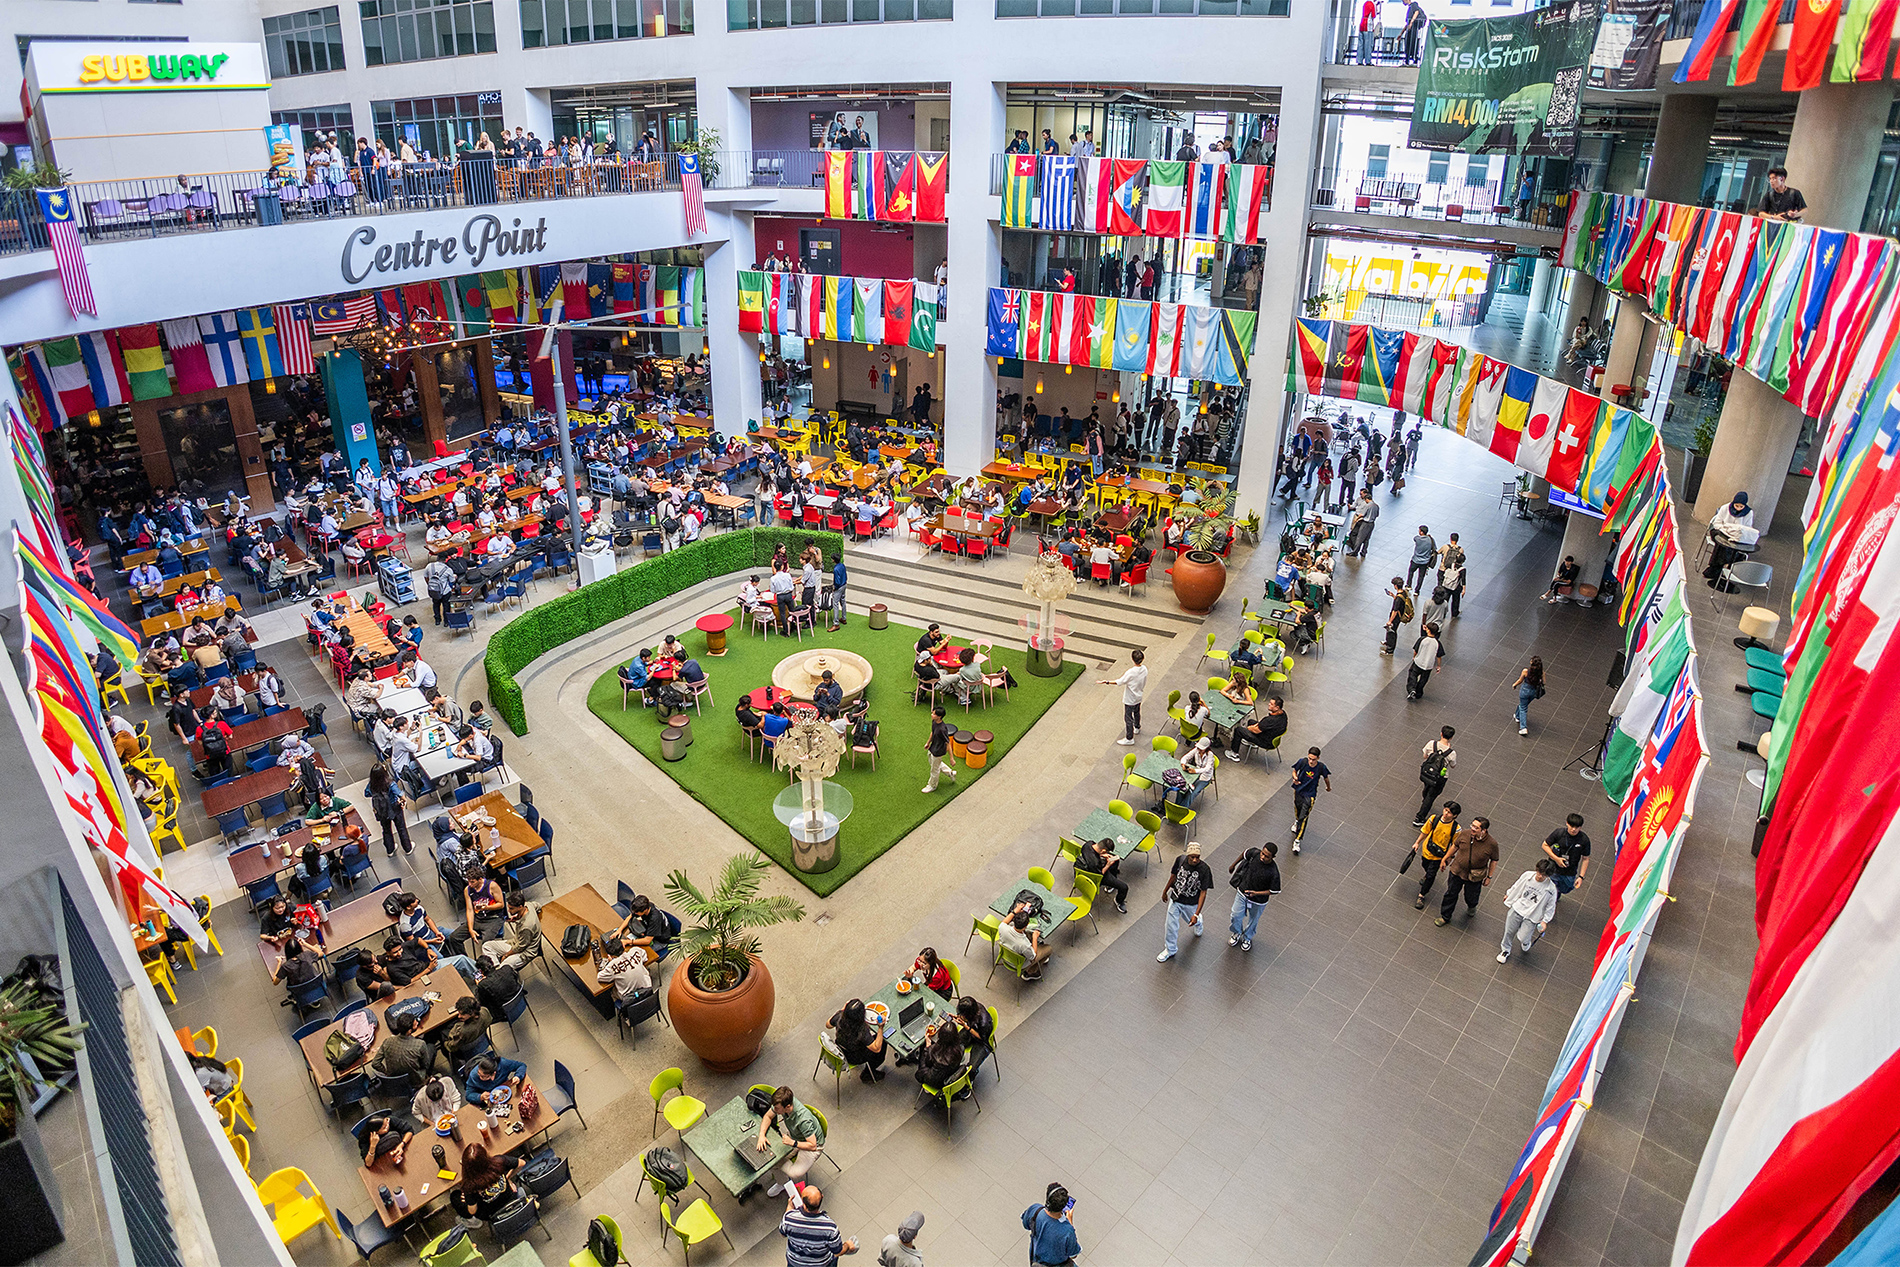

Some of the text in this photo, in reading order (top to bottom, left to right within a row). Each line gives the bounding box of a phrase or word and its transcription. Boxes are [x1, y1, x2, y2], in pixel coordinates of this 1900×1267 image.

[79, 52, 230, 83] SUBWAY
[1432, 45, 1540, 69] RiskStorm
[1421, 97, 1499, 128] RM4,000
[341, 214, 548, 284] Centre Point
